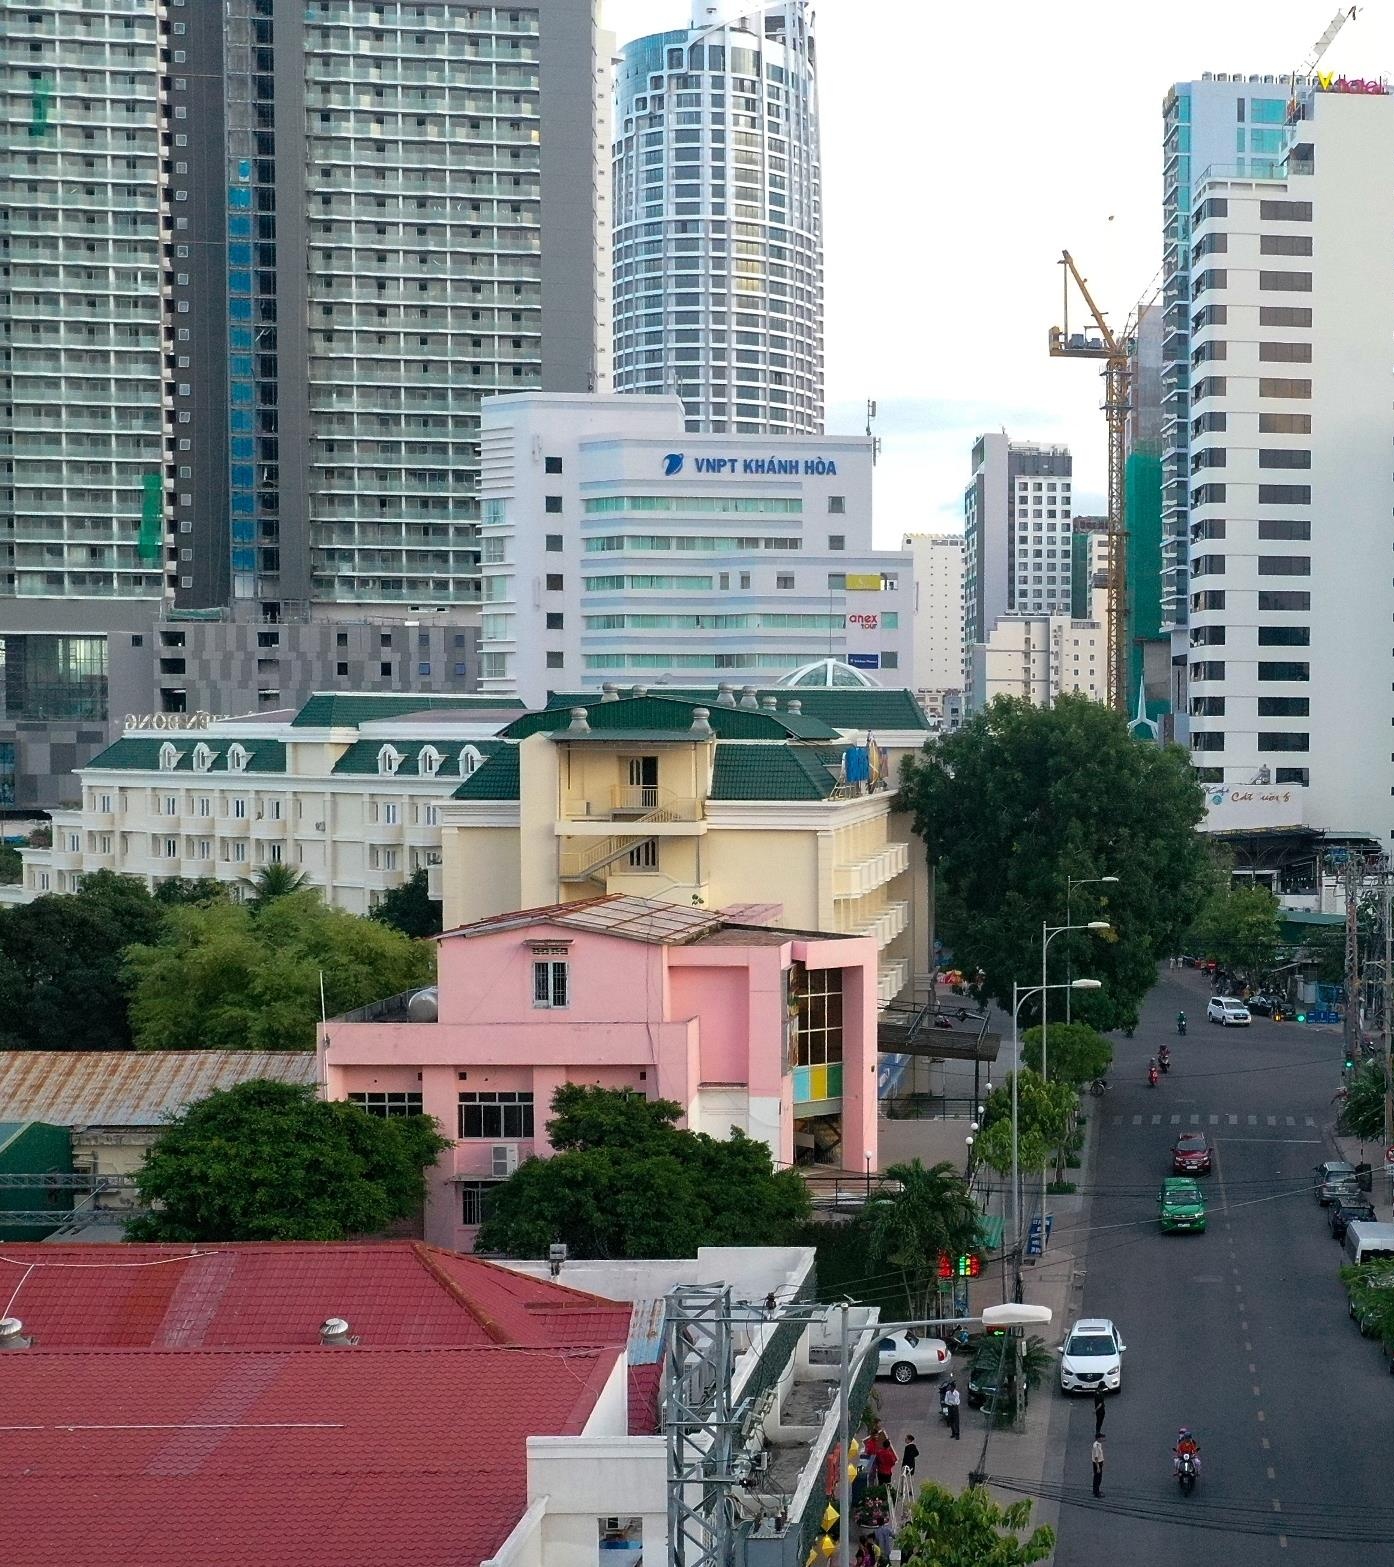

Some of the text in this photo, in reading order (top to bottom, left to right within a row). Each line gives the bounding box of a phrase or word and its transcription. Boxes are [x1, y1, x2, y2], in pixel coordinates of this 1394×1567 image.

[694, 456, 837, 475] VNPT KHÁNH HÒA
[849, 614, 877, 623] anex
